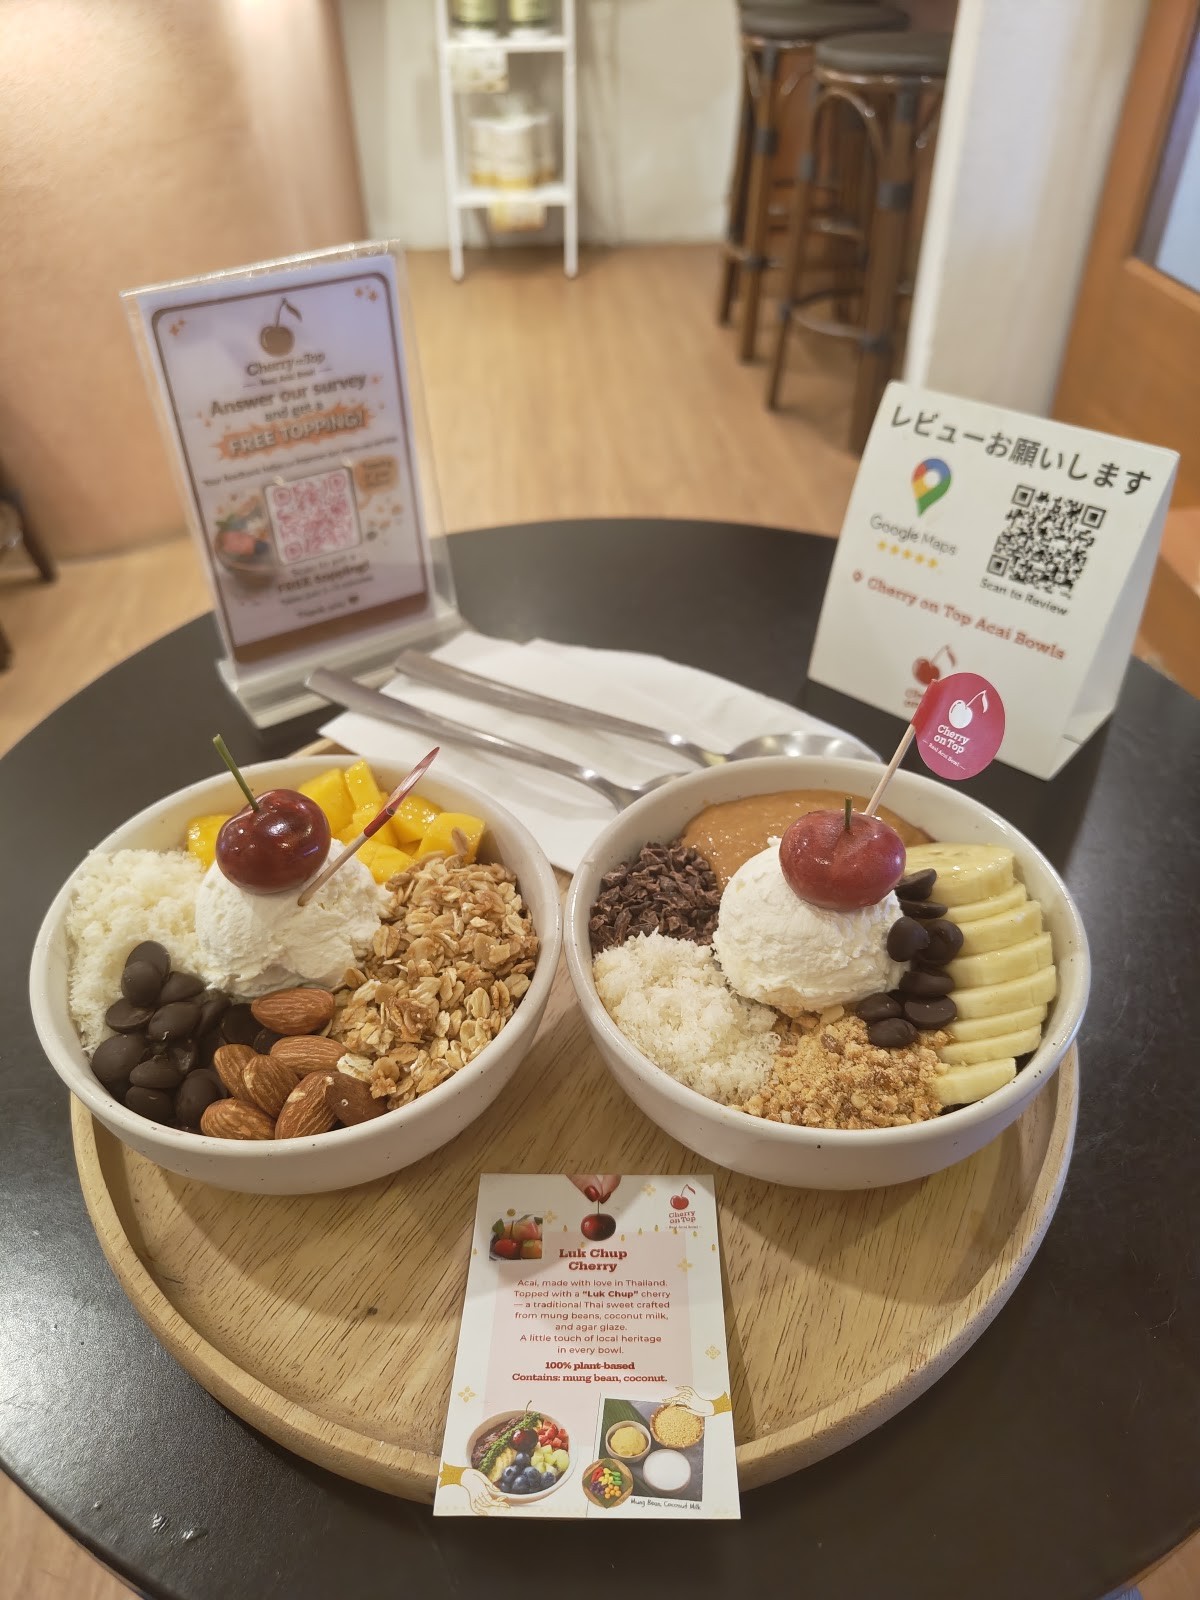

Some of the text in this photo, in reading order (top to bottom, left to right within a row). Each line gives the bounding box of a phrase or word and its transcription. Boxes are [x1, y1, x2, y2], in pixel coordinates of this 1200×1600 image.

[212, 394, 273, 417] Answer
[280, 388, 307, 402] our
[313, 375, 366, 395] survey
[265, 407, 289, 422] and
[292, 403, 311, 418] get
[231, 431, 276, 455] FREE
[891, 406, 1151, 495] レビューお願いします
[870, 513, 958, 557] Google Maps
[980, 578, 1068, 616] Scan to Review
[868, 578, 1065, 660] Cherry on Top Acai Bowls
[937, 724, 970, 745] Cherry
[559, 1249, 627, 1260] Luk Chup
[569, 1261, 617, 1272] Cherry
[514, 1291, 548, 1299] Topped
[641, 1291, 670, 1299] cherry
[572, 1312, 602, 1320] beans,
[646, 1312, 668, 1320] milk,
[621, 1335, 661, 1343] heritage
[574, 1362, 635, 1370] plant-based
[563, 1375, 591, 1383] mung
[594, 1374, 621, 1383] bean,
[630, 1498, 645, 1507] Mung
[664, 1501, 688, 1509] Coconut
